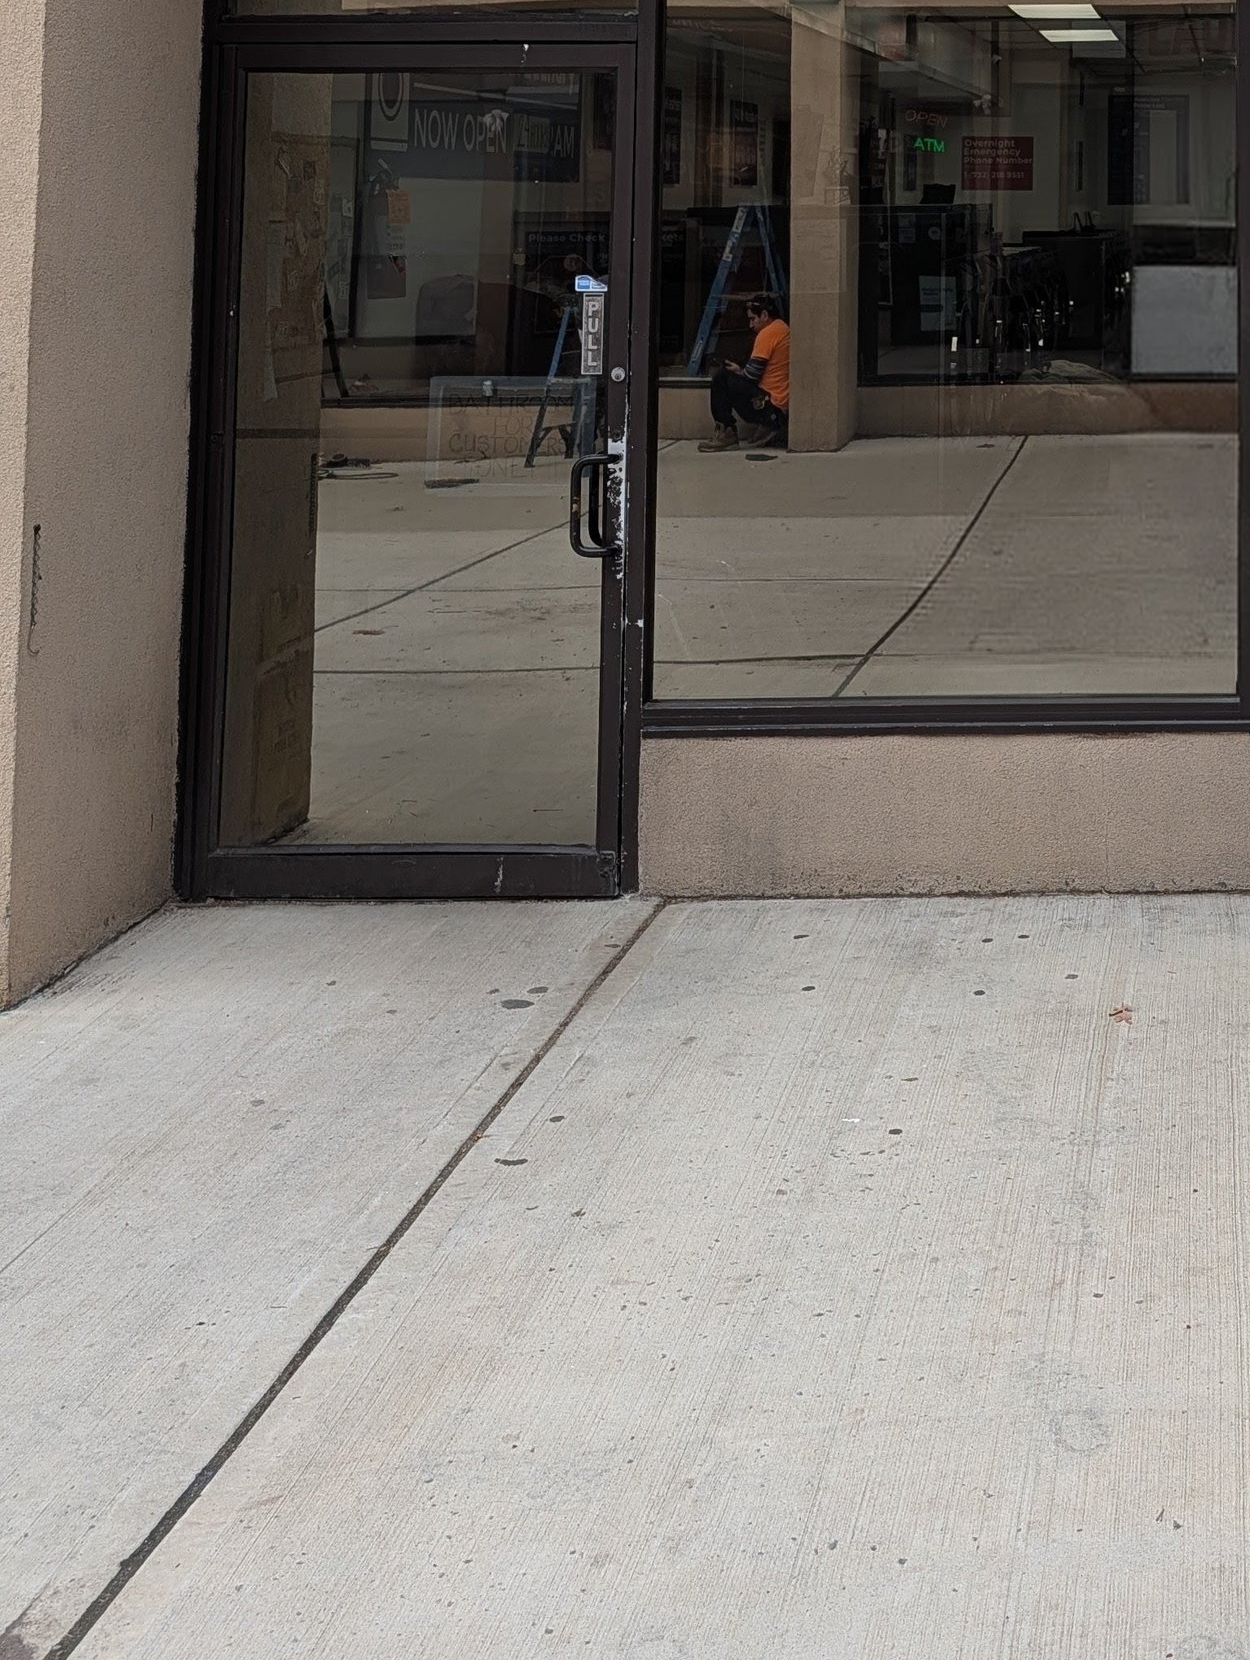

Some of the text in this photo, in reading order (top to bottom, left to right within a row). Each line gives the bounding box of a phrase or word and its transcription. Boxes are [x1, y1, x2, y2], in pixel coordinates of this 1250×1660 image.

[905, 108, 948, 129] OPEN
[414, 108, 460, 150] NOW
[463, 113, 508, 154] OPEN
[913, 137, 945, 153] ATM
[963, 148, 1021, 157] Emergency
[964, 139, 1016, 148] Overnight
[963, 156, 1033, 165] Phone Number
[528, 233, 566, 244] Please
[568, 233, 606, 243] Check
[587, 301, 600, 367] PULL
[494, 416, 535, 436] FOR
[448, 433, 566, 454] CUSTOMRS
